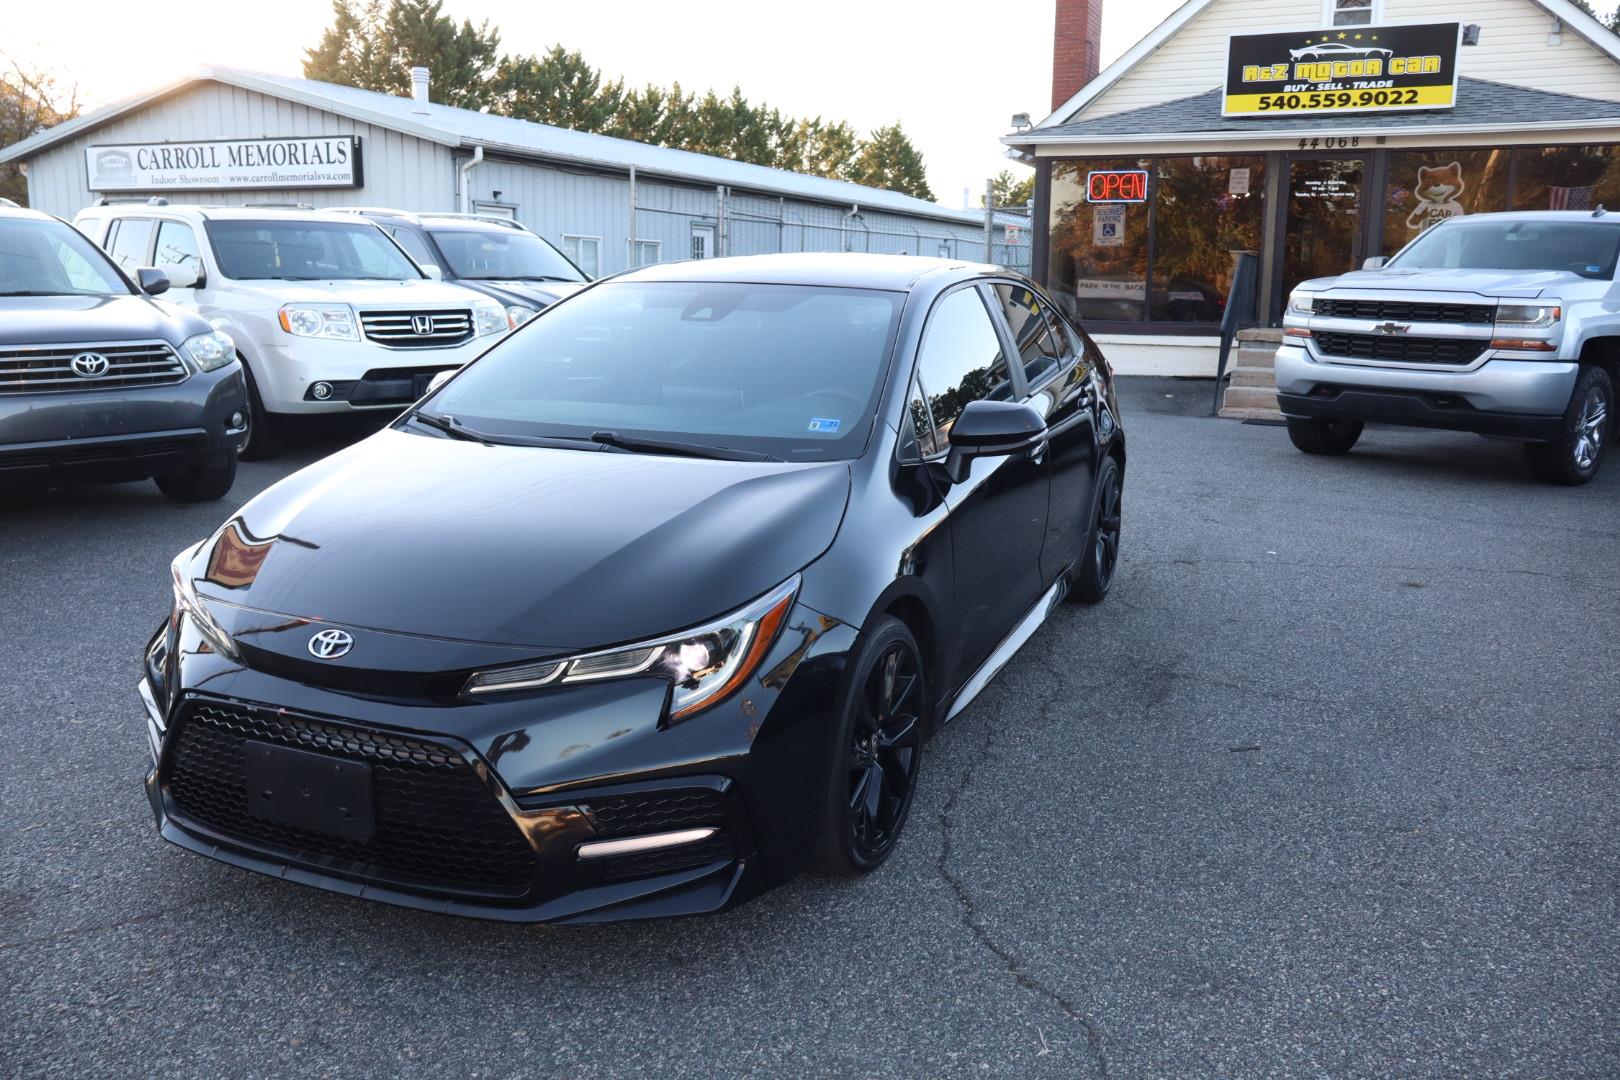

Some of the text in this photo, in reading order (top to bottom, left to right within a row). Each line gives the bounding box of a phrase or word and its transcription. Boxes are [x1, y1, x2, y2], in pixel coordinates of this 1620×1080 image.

[1283, 80, 1394, 92] BUY SELL TRADE
[1258, 89, 1419, 111] 540.559.9022
[137, 141, 347, 170] CARROLL MEMORIALS
[151, 170, 351, 185] Indoor Showroom www.carrollmemorialsva.com
[1090, 174, 1145, 199] OPEN
[1430, 208, 1452, 219] CAR
